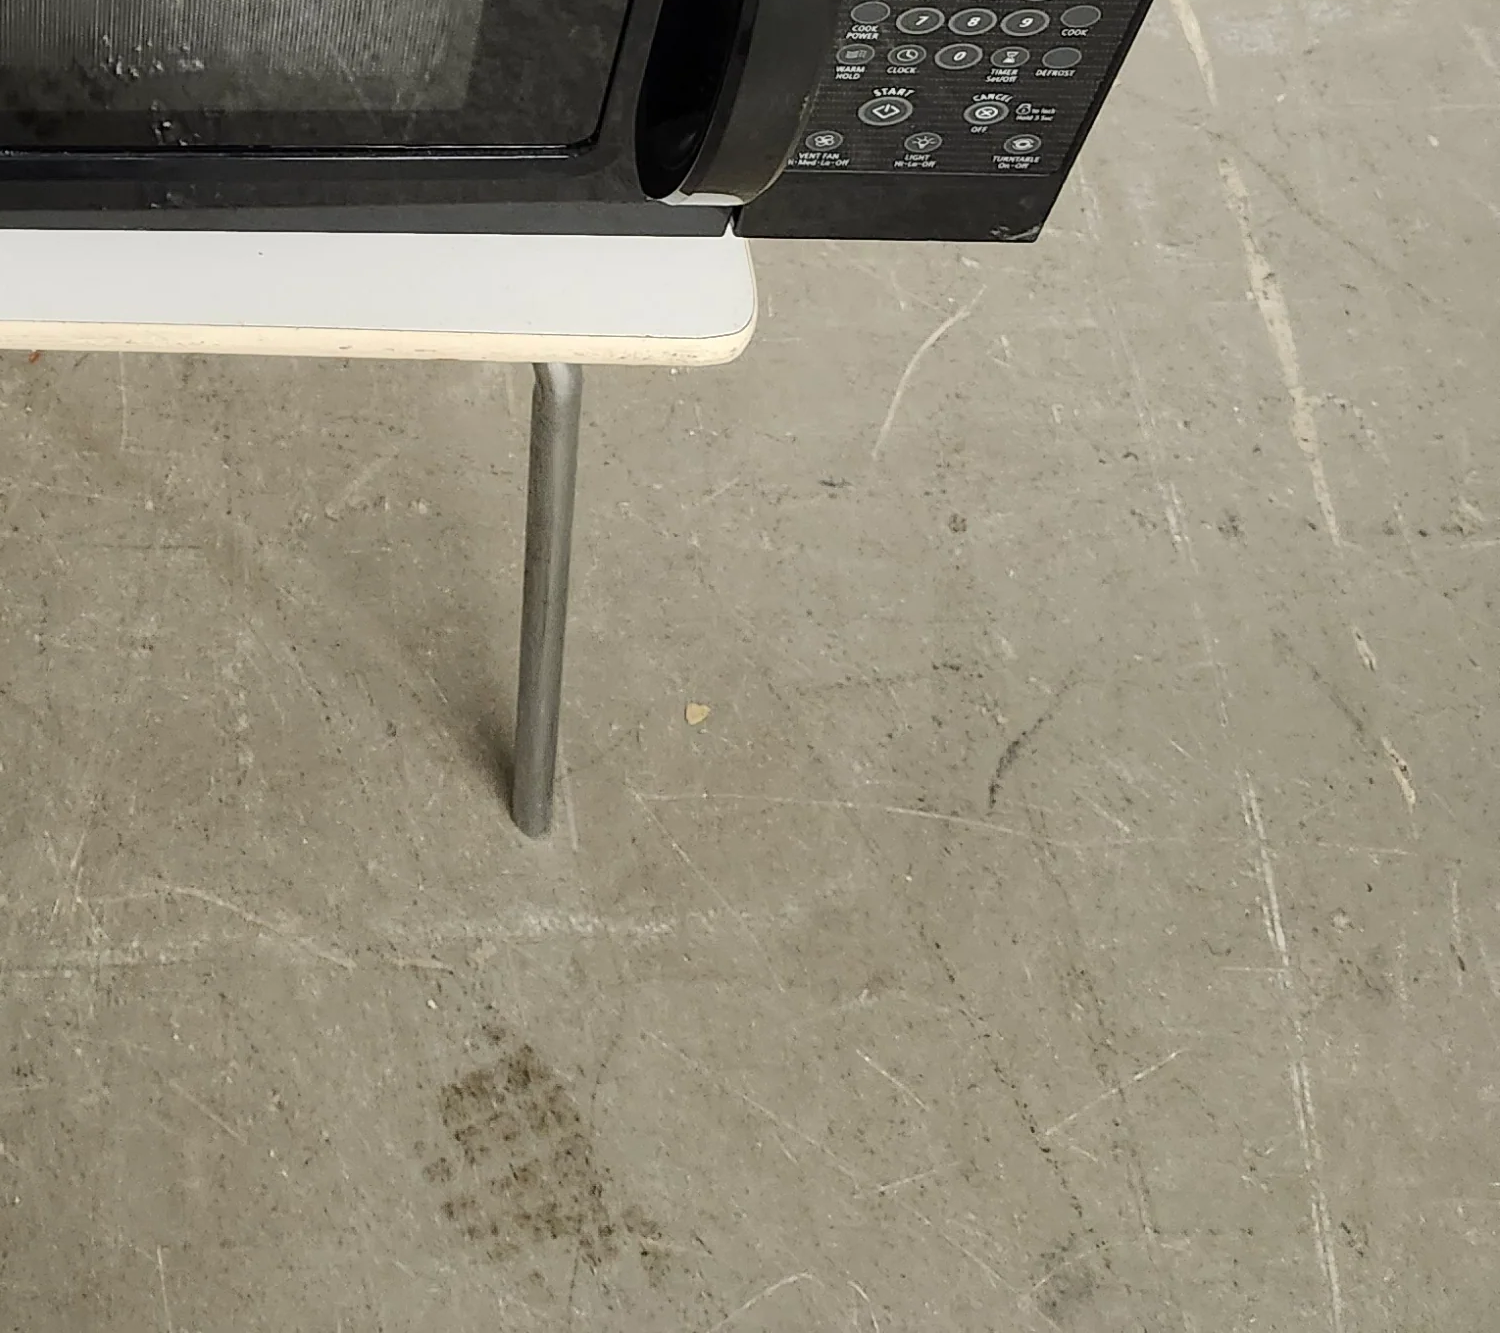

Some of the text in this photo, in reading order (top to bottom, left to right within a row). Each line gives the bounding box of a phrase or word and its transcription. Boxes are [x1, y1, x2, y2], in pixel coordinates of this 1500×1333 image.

[915, 15, 929, 26] 7
[967, 16, 982, 27] 8
[1019, 17, 1034, 28] 9
[851, 24, 879, 32] COOK
[1061, 28, 1089, 37] COOK
[845, 32, 880, 40] POWER
[953, 51, 967, 61] 0
[886, 66, 917, 74] CLOCK
[990, 68, 1019, 76] TIMER
[1035, 69, 1076, 77] DEFROST
[872, 87, 916, 97] START
[972, 93, 1014, 103] CANCEL
[798, 152, 820, 160] VENT
